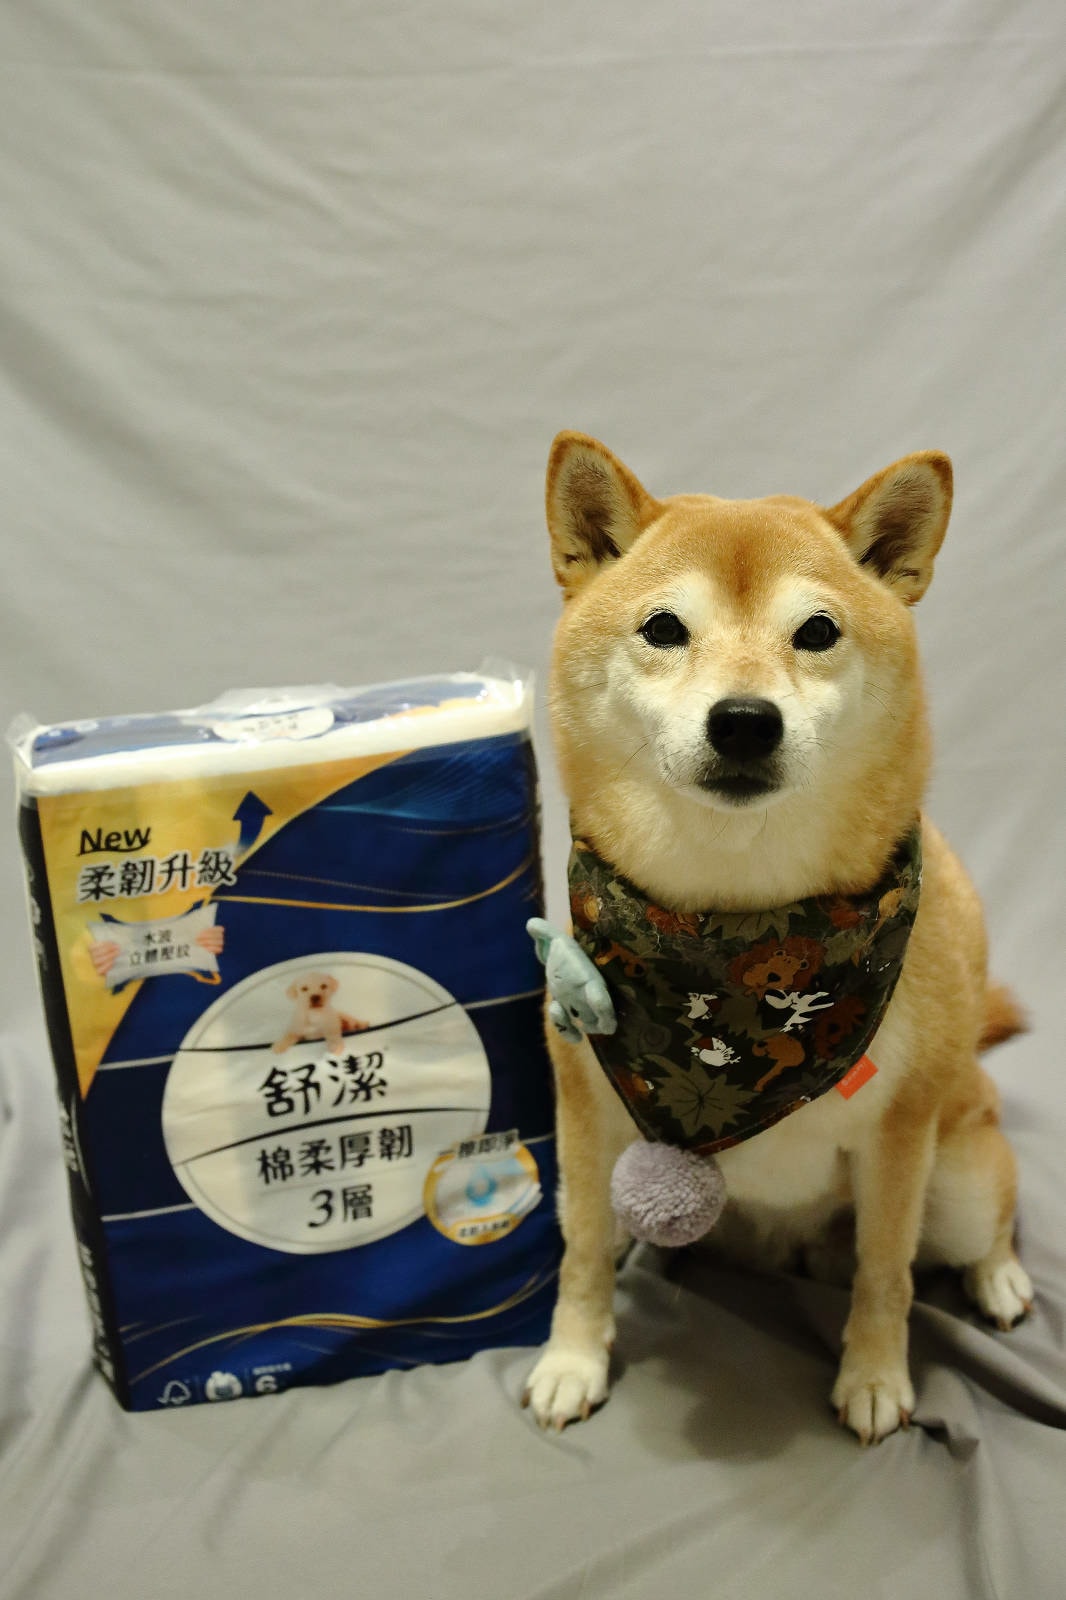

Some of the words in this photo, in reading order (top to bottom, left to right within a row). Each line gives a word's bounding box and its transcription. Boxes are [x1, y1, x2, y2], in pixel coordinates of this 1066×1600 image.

[78, 827, 151, 855] New
[80, 851, 234, 901] 柔韌升級
[257, 1051, 388, 1117] 舒潔
[256, 1124, 413, 1185] 棉柔厚韌
[307, 1184, 373, 1228] 3層
